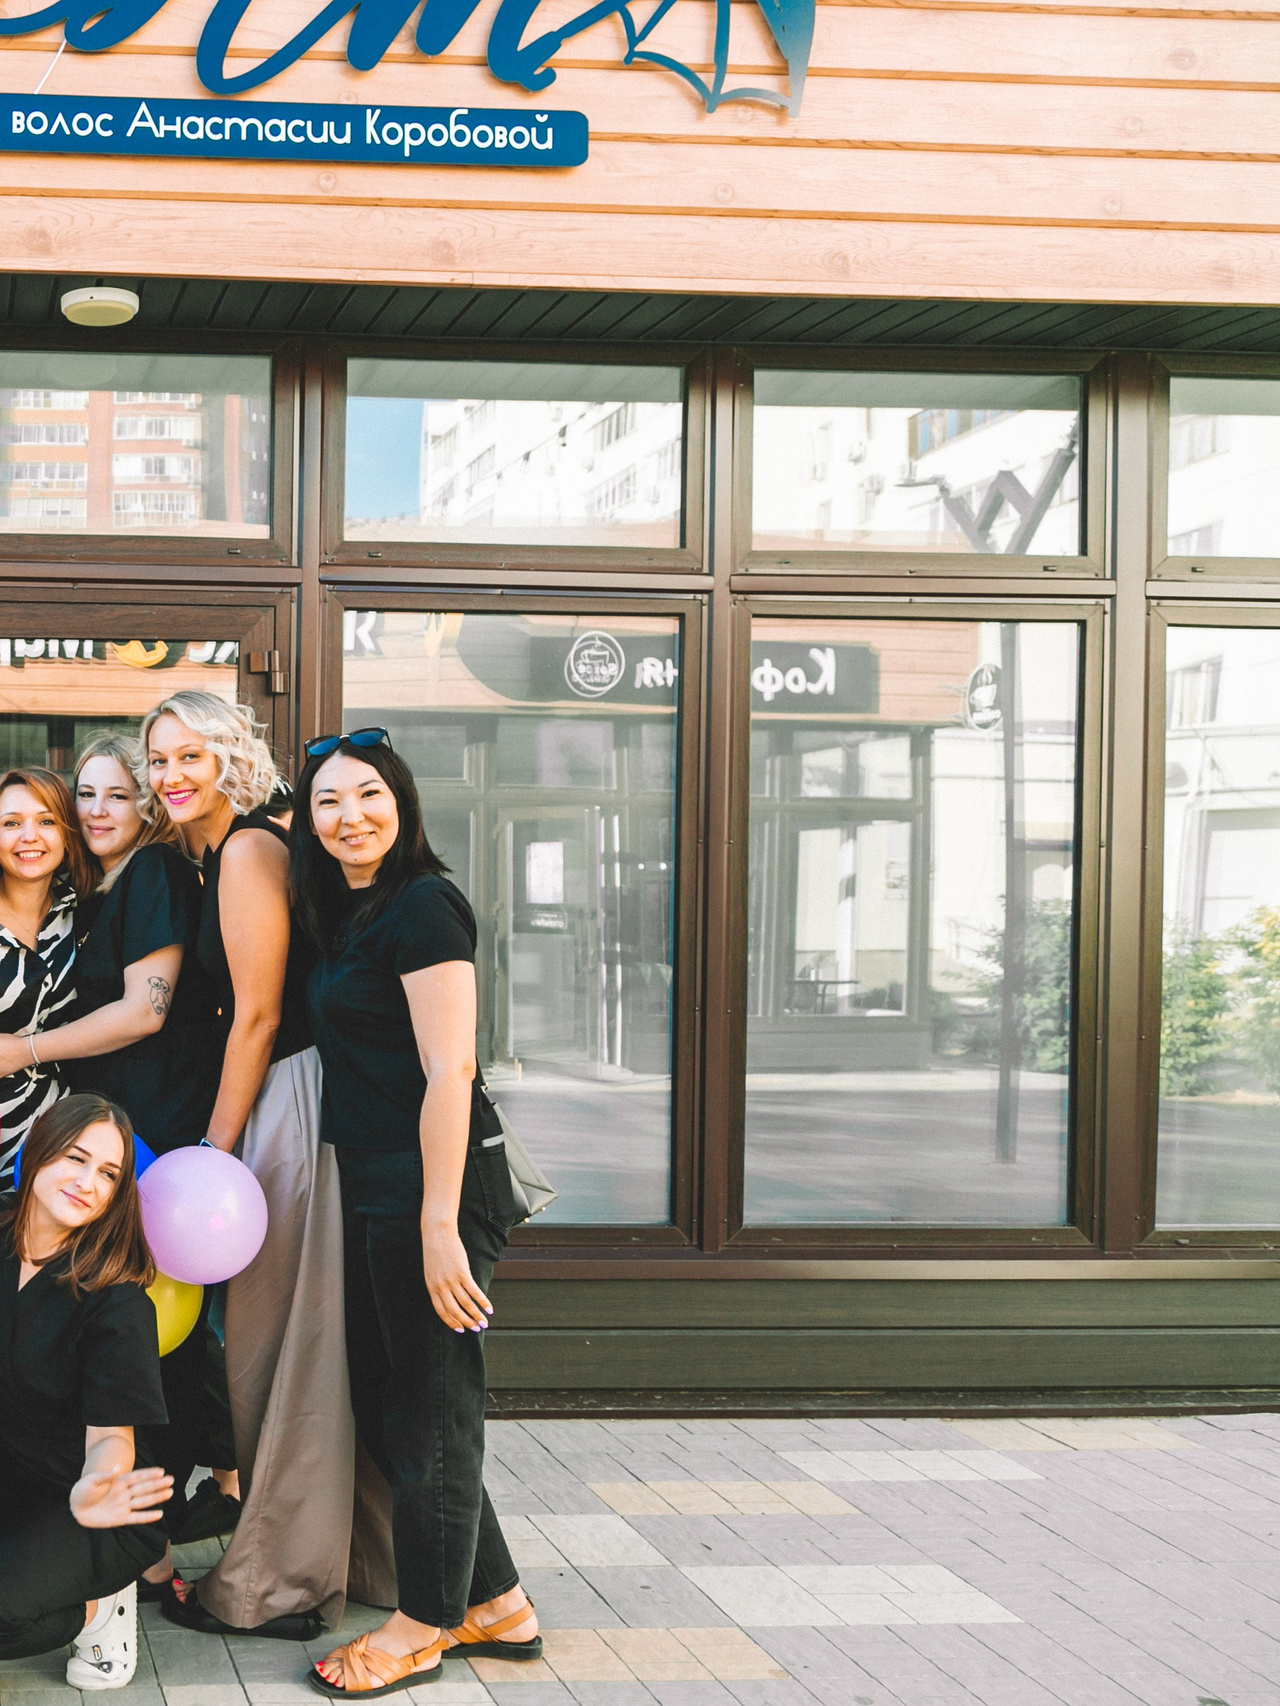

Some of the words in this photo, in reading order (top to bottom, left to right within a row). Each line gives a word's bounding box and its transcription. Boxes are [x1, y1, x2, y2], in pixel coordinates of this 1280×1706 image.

[11, 110, 114, 138] волос
[125, 101, 352, 146] Анастасии
[365, 107, 554, 158] Коробовой
